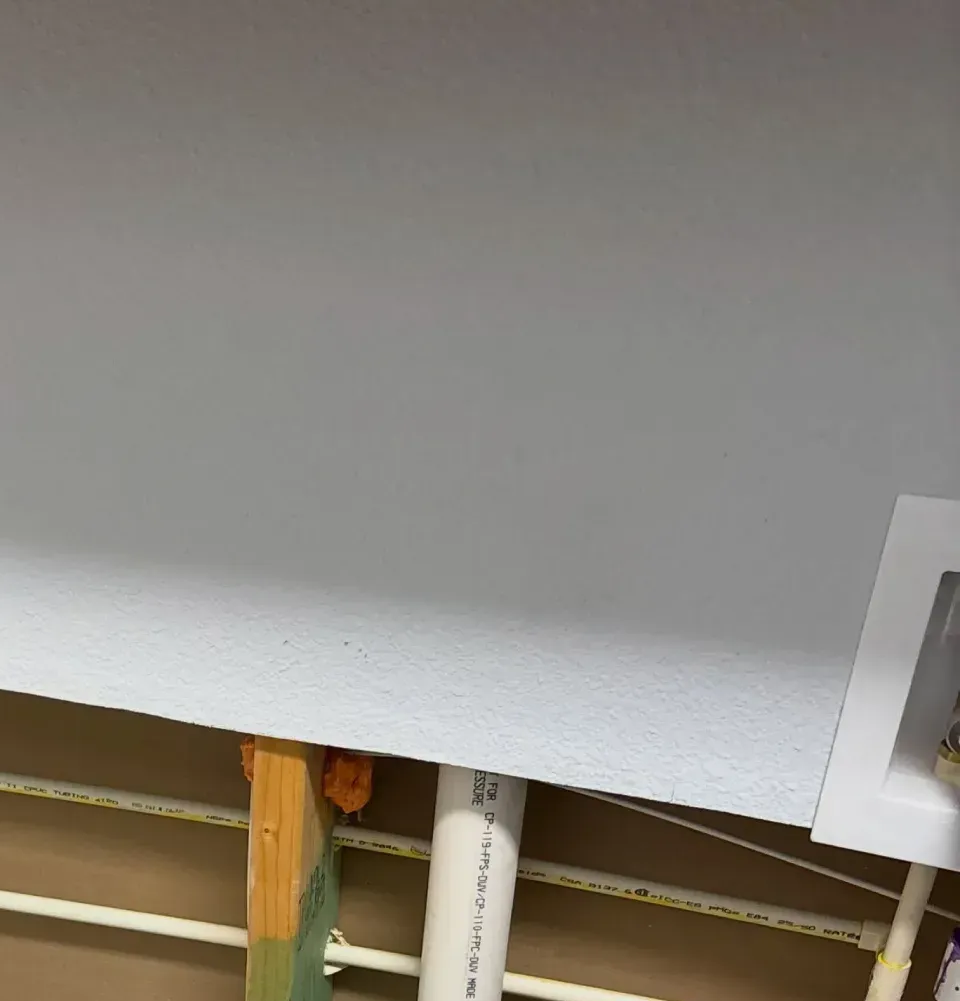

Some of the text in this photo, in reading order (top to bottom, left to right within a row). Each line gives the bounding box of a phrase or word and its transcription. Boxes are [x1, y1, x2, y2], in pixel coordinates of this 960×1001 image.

[472, 770, 487, 806] ESSURE
[487, 782, 498, 801] FOR
[466, 978, 477, 999] MADE
